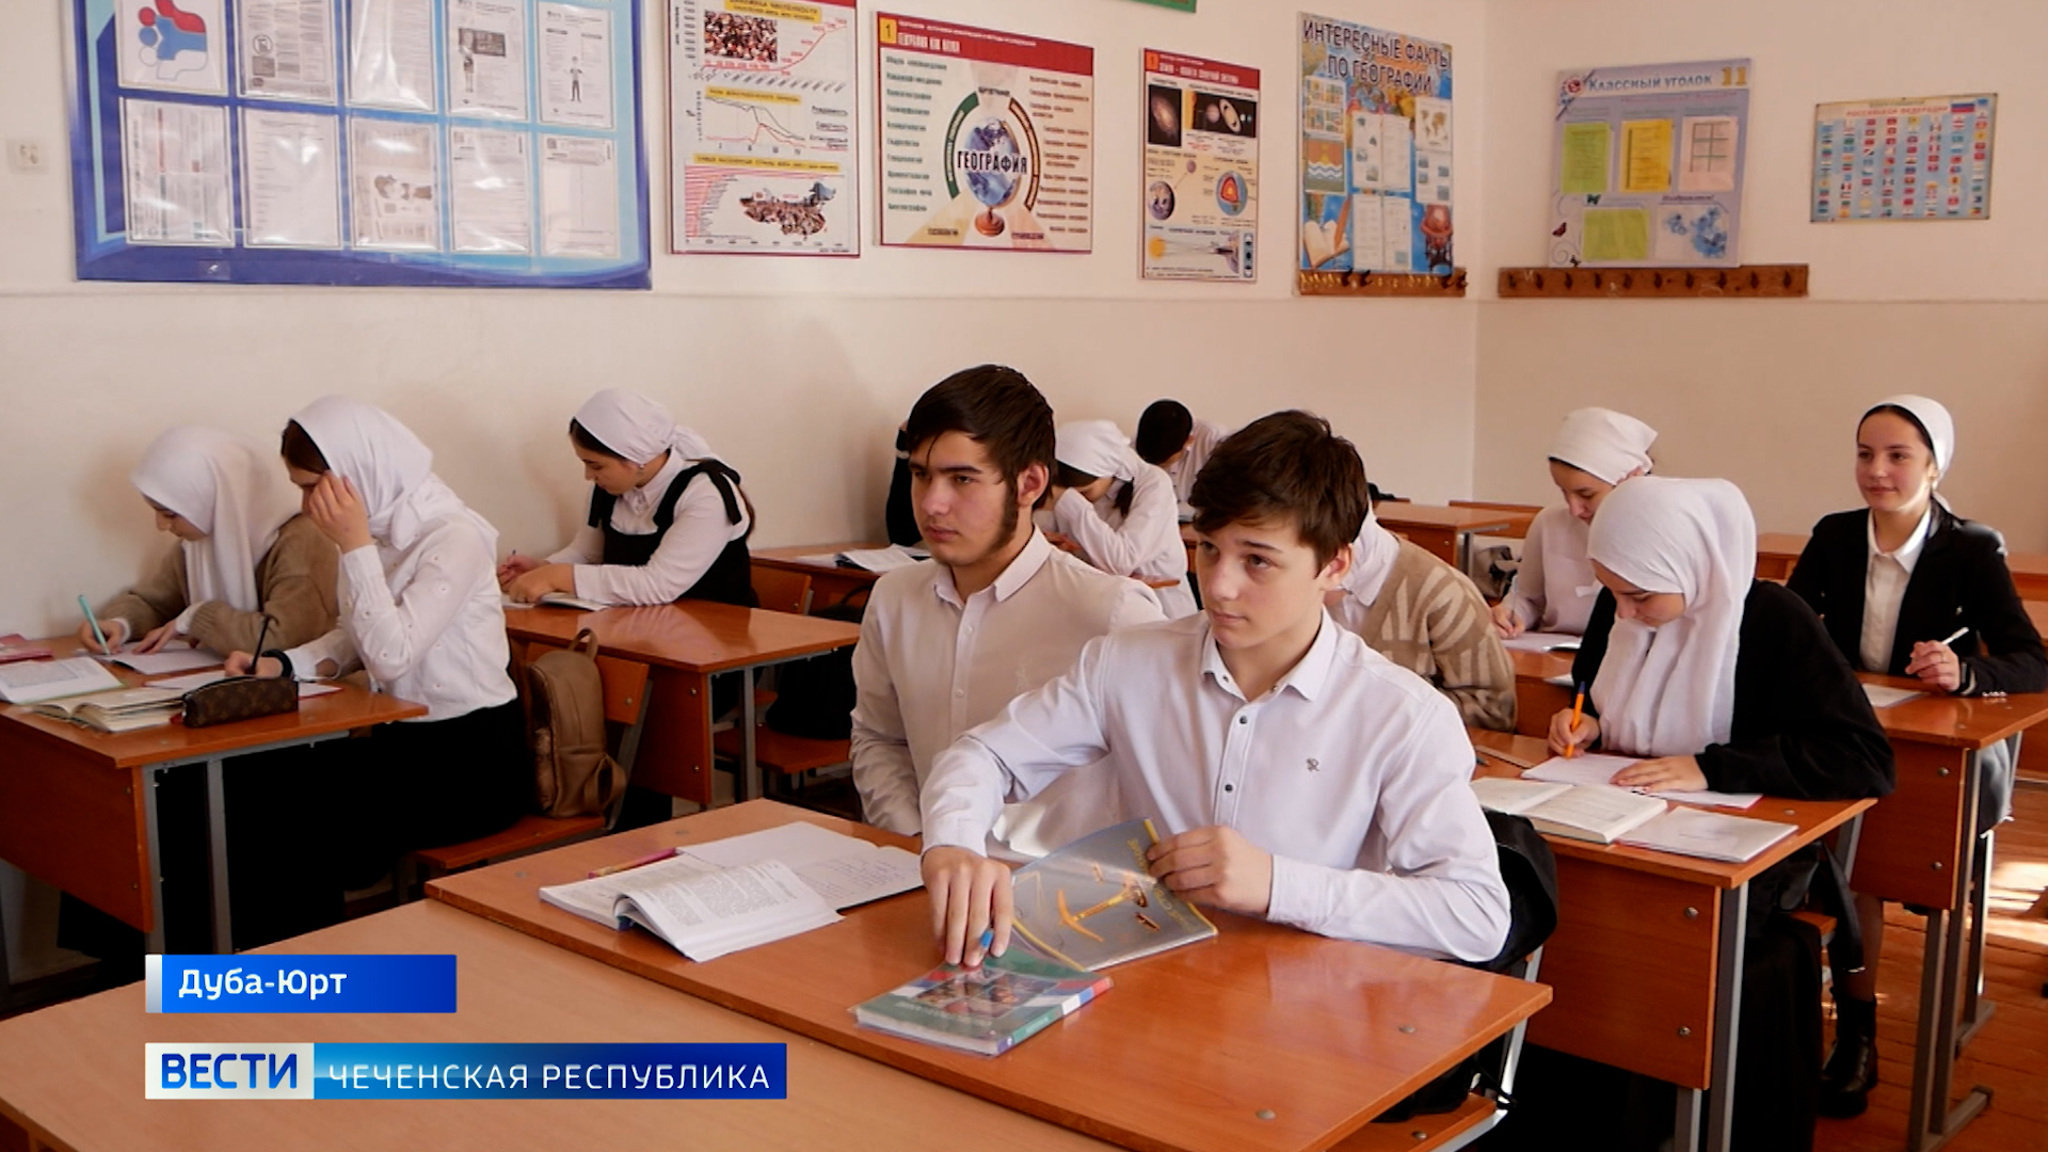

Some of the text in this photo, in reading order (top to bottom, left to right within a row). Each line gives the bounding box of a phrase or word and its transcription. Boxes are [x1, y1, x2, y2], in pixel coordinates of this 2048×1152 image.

[885, 23, 892, 38] 1
[1303, 19, 1451, 68] ИНТЕРЕСНЫЕ ФАКТЫ
[1328, 54, 1432, 91] ПО ГЕОГРАФИИ
[1666, 74, 1713, 88] уголок
[1722, 66, 1747, 86] 11
[957, 150, 1028, 174] ГЕОГРАФИЯ
